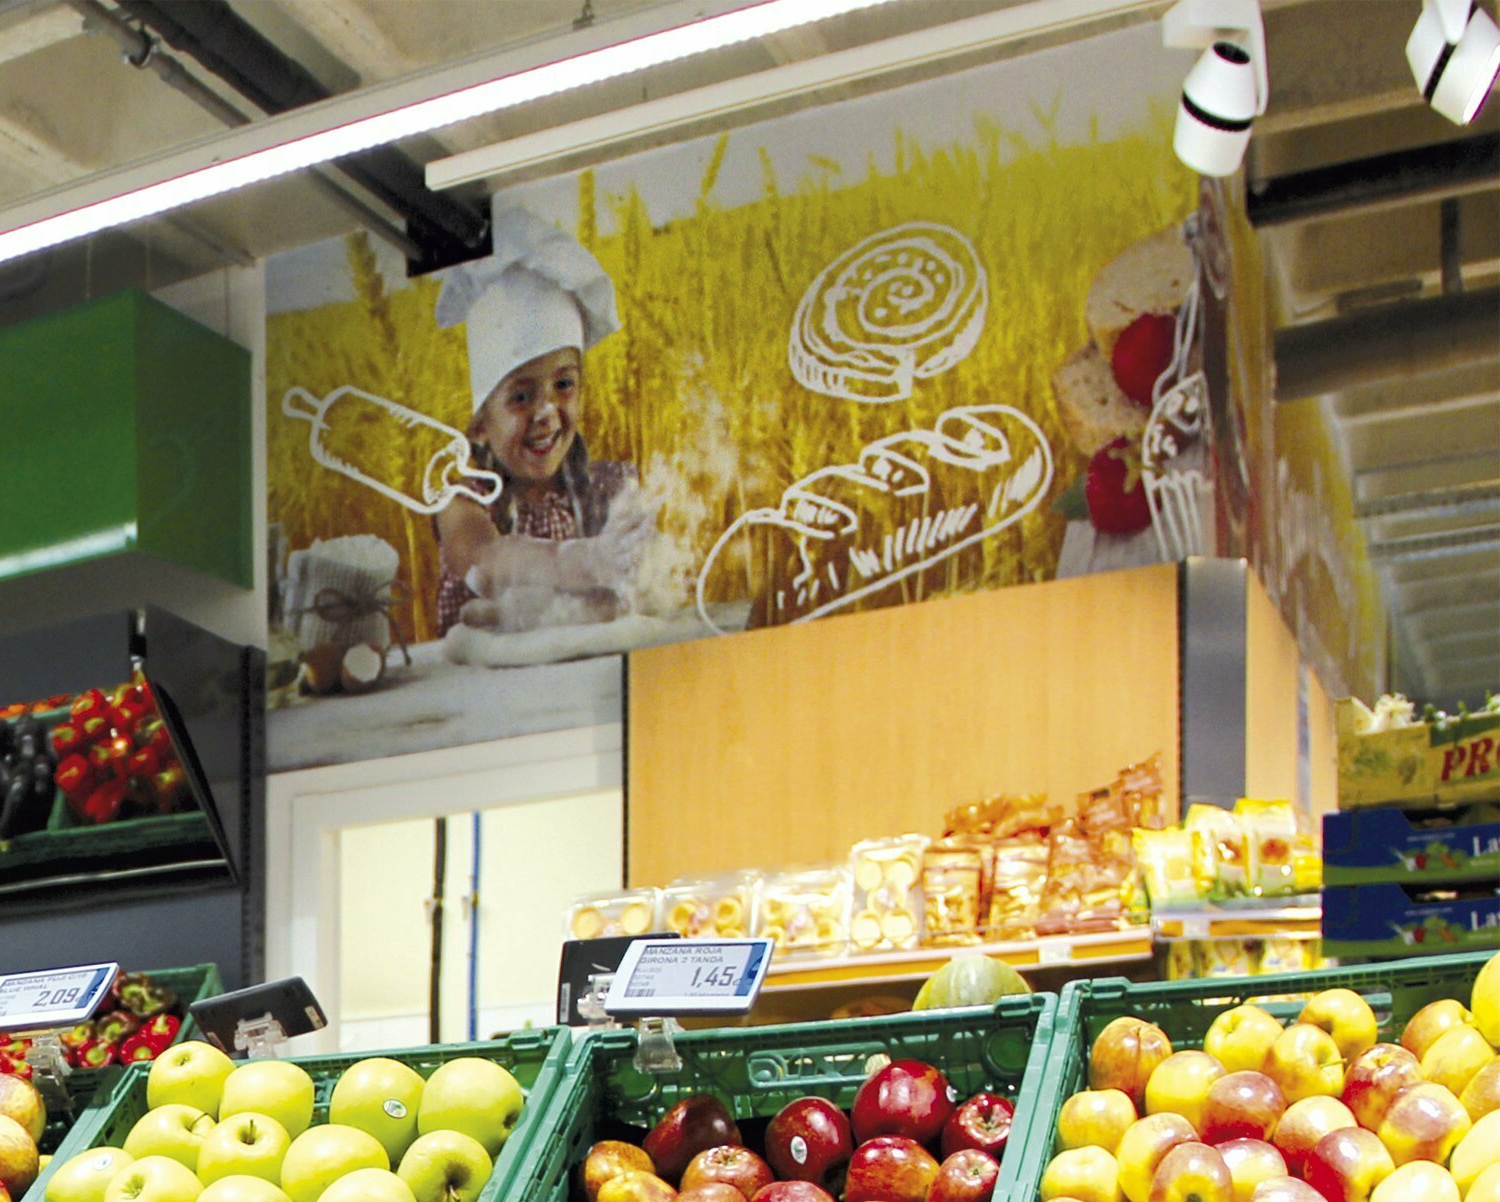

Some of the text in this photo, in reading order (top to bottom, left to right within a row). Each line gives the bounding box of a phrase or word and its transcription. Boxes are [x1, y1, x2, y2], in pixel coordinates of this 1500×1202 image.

[1441, 737, 1500, 781] PR
[645, 946, 723, 955] MANZANA ROJA
[640, 956, 678, 964] GIRONA
[690, 956, 724, 964] TANDA
